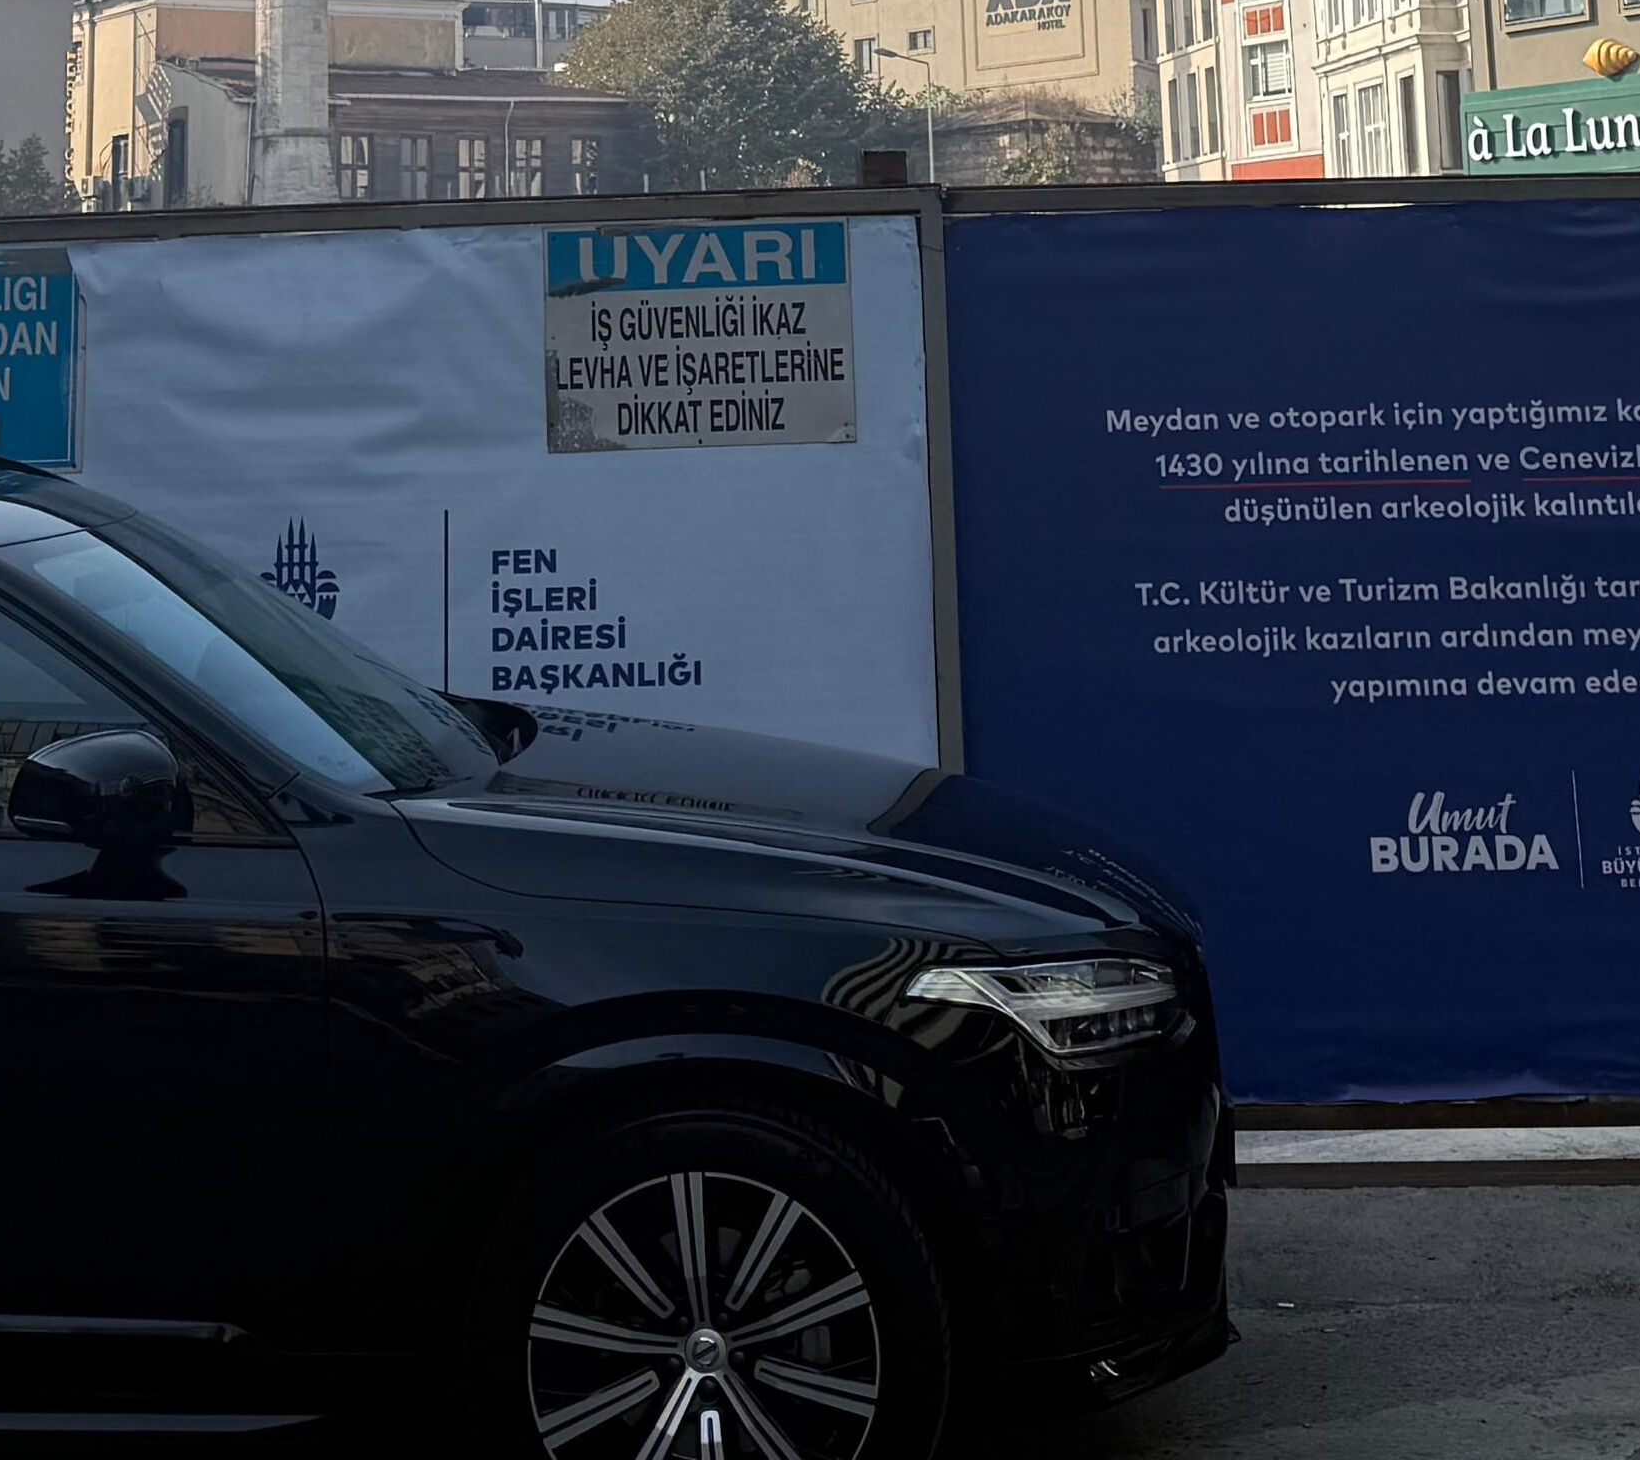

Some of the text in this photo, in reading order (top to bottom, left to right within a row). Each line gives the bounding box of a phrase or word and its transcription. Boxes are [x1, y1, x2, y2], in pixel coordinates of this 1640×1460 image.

[1038, 19, 1066, 31] HOTEL
[1468, 116, 1493, 161] à
[1502, 113, 1552, 158] La
[579, 229, 816, 285] UYARI
[591, 295, 806, 351] İŞ GÜVENLİĞİ İKAZ
[556, 340, 845, 395] LEVHA VE İŞARETLERİNE
[617, 389, 786, 435] DİKKAT EDİNİZ
[1105, 407, 1219, 438] Meydan
[1228, 411, 1261, 431] ve
[1269, 403, 1386, 433] otopark
[1393, 401, 1444, 431] için
[1452, 399, 1608, 431] yaptığımız
[1155, 454, 1223, 478] 1430
[1232, 451, 1310, 482] yılına
[1317, 448, 1469, 475] tarihlenen
[1477, 450, 1510, 470] ve
[1224, 495, 1372, 526] düşünülen
[1381, 492, 1526, 524] arkeolojik
[492, 548, 557, 575] FEN
[492, 577, 597, 618] İŞLERİ
[1135, 582, 1191, 607] T.C.
[1199, 579, 1290, 606] Kültür
[1298, 585, 1332, 604] ve
[1338, 577, 1439, 603] Turizm
[1449, 573, 1586, 605] Bakanlığı
[492, 615, 626, 652] DAİRESİ
[1153, 627, 1297, 658] arkeolojik
[1305, 625, 1431, 651] kazıların
[1440, 622, 1573, 649] ardından
[492, 652, 702, 695] BAŞKANLIĞI
[1331, 677, 1467, 704] yapımına
[1476, 671, 1576, 696] devam
[1408, 790, 1517, 835] Umut
[1369, 834, 1559, 873] BURADA
